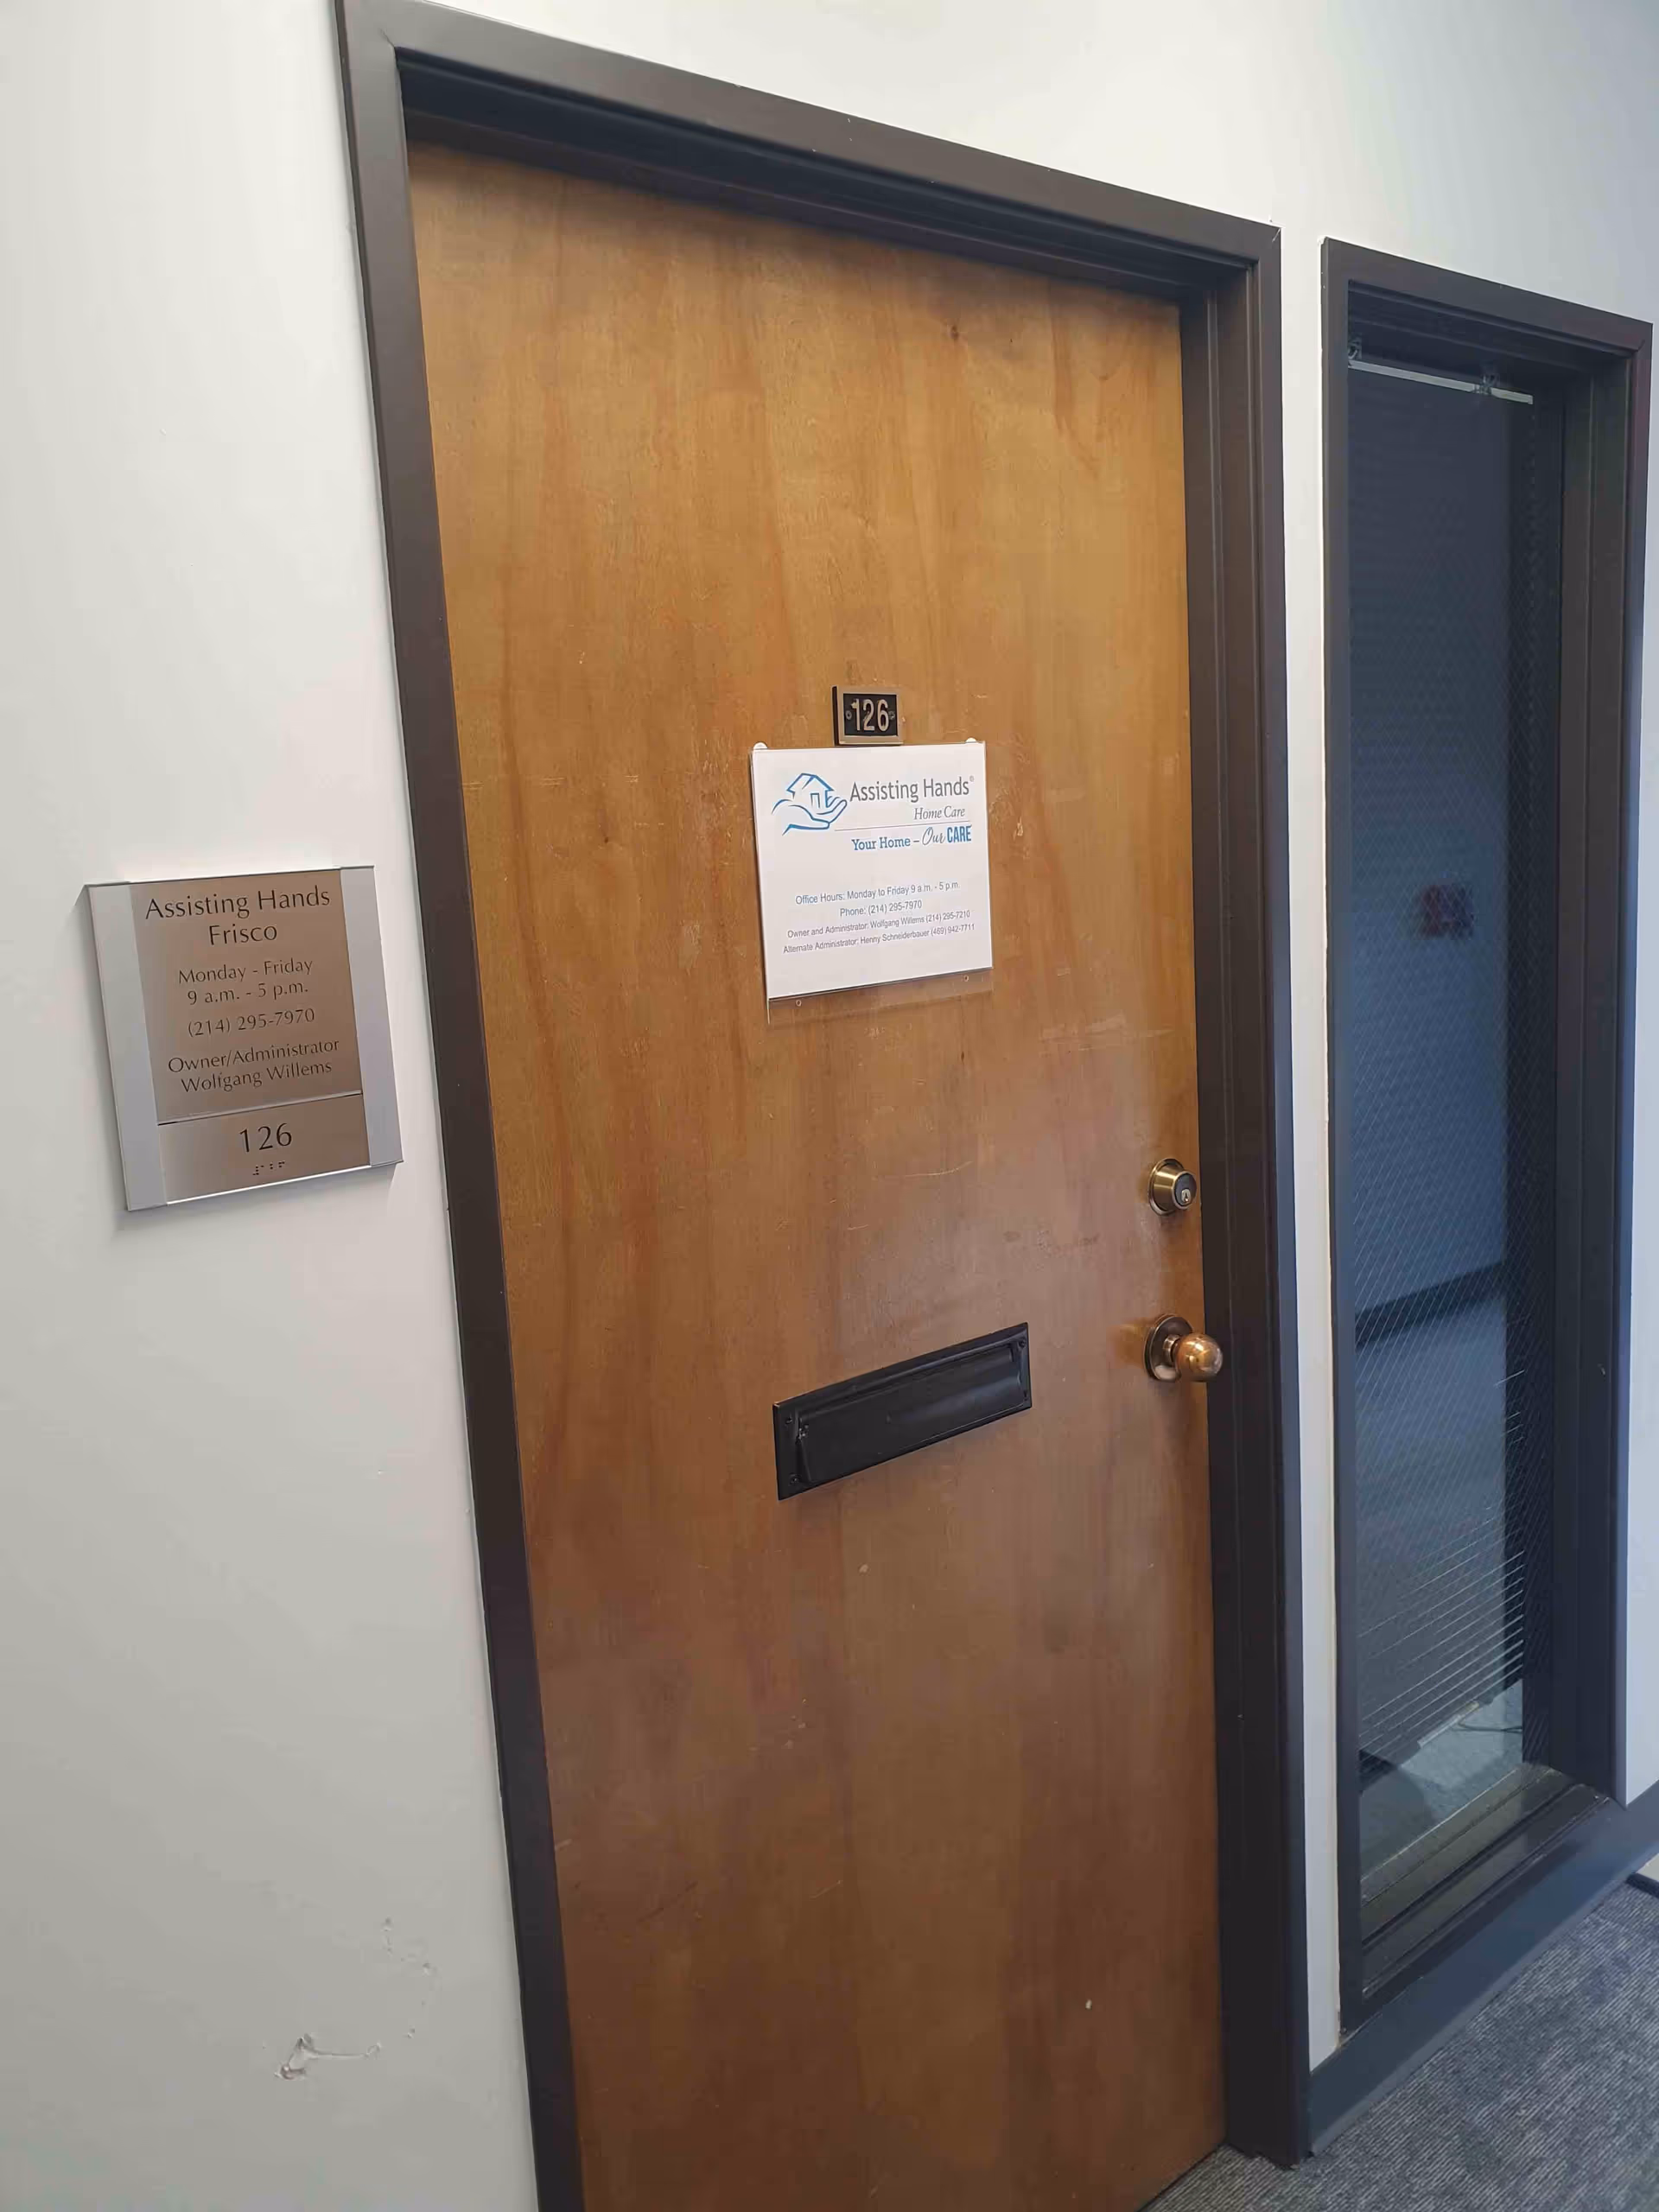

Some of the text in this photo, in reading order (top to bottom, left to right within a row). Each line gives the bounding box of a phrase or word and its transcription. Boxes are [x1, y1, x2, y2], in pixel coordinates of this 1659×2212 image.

[851, 698, 889, 732] 126
[849, 780, 918, 803] Assisting
[913, 805, 965, 820] Home Care
[851, 836, 876, 851] Your
[879, 836, 911, 849] Home
[922, 826, 945, 846] Our
[947, 824, 972, 843] CARE
[145, 884, 331, 919] Assisting Hands
[795, 895, 818, 905] Office
[820, 892, 845, 903] Hours:
[847, 888, 876, 899] Monday
[887, 886, 909, 896] Friday
[911, 884, 916, 893] 9
[917, 884, 933, 893] am.
[939, 881, 944, 890] 5
[840, 899, 922, 918] Phone: (214) 295-7970
[208, 923, 278, 946] Frisco
[787, 930, 810, 939] Owner
[810, 927, 823, 936] and
[870, 918, 899, 930] Wolfgang
[900, 916, 925, 926] Willems
[925, 912, 942, 924] (214)
[783, 944, 814, 955] Alternate
[881, 928, 930, 943] Schneiderbauer
[178, 963, 247, 985] Monday
[264, 957, 314, 976] Friday
[187, 989, 198, 1006] 9
[204, 988, 241, 1004] a.m.
[257, 982, 267, 998] 5
[273, 982, 309, 1001] p.m.
[188, 1007, 316, 1038] (214) 295-7970
[168, 1039, 340, 1074] Owner/Administrator
[181, 1061, 334, 1093] Wolfgang Willems
[238, 1122, 293, 1154] 126
